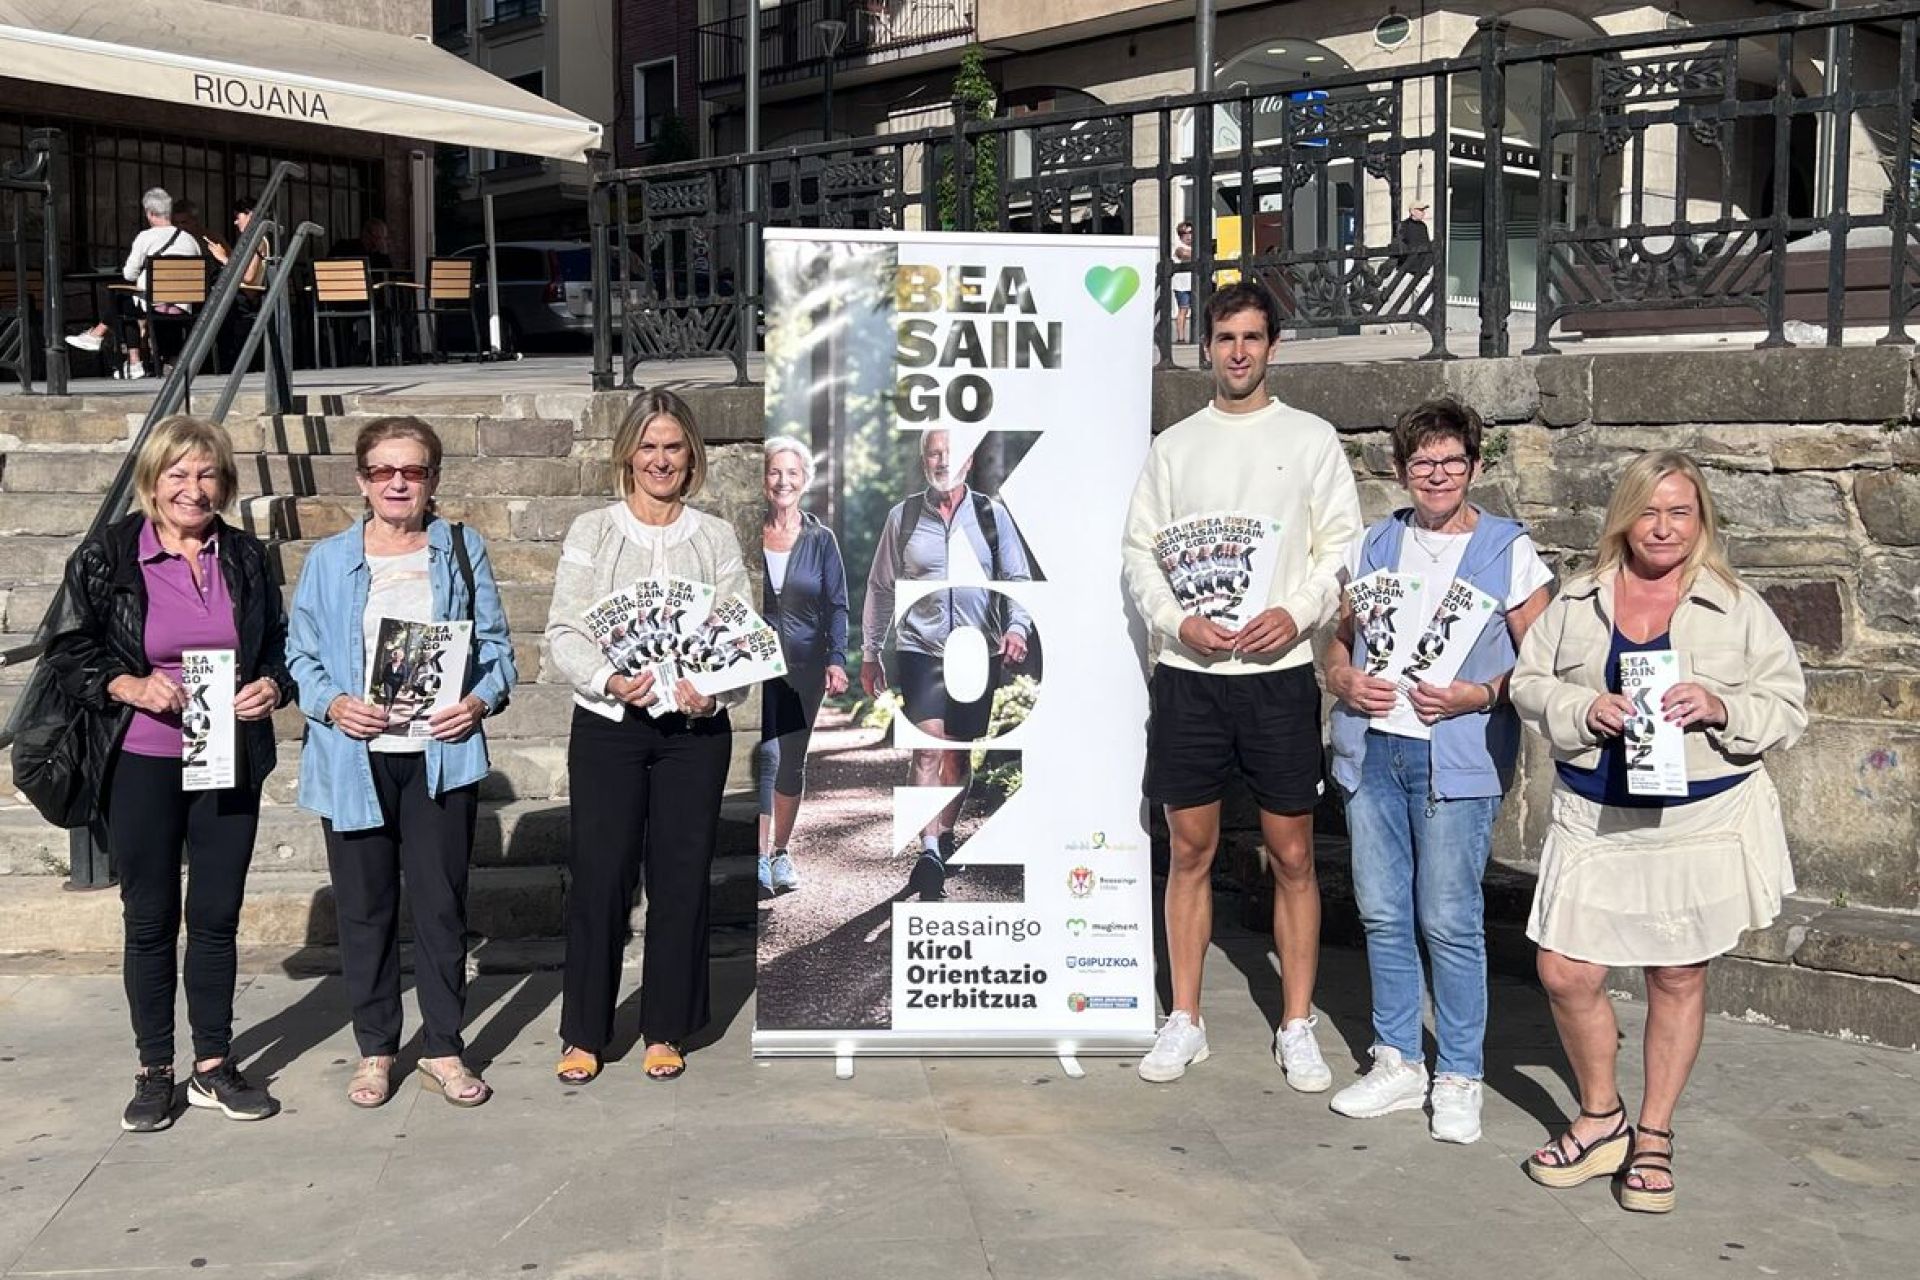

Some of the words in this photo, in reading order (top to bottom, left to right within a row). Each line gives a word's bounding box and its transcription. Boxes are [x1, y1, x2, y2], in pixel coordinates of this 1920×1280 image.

[194, 74, 329, 120] RIOJANA
[896, 264, 1037, 314] BEA
[896, 319, 1063, 369] SAIN
[896, 374, 994, 423] GO
[907, 916, 1042, 943] Beasaingo
[1092, 922, 1138, 932] mugiment
[907, 940, 972, 961] Kirol
[1078, 957, 1138, 968] GIPUZKOA
[907, 963, 1047, 985] Orientazio
[907, 988, 1037, 1009] Zerbitzua
